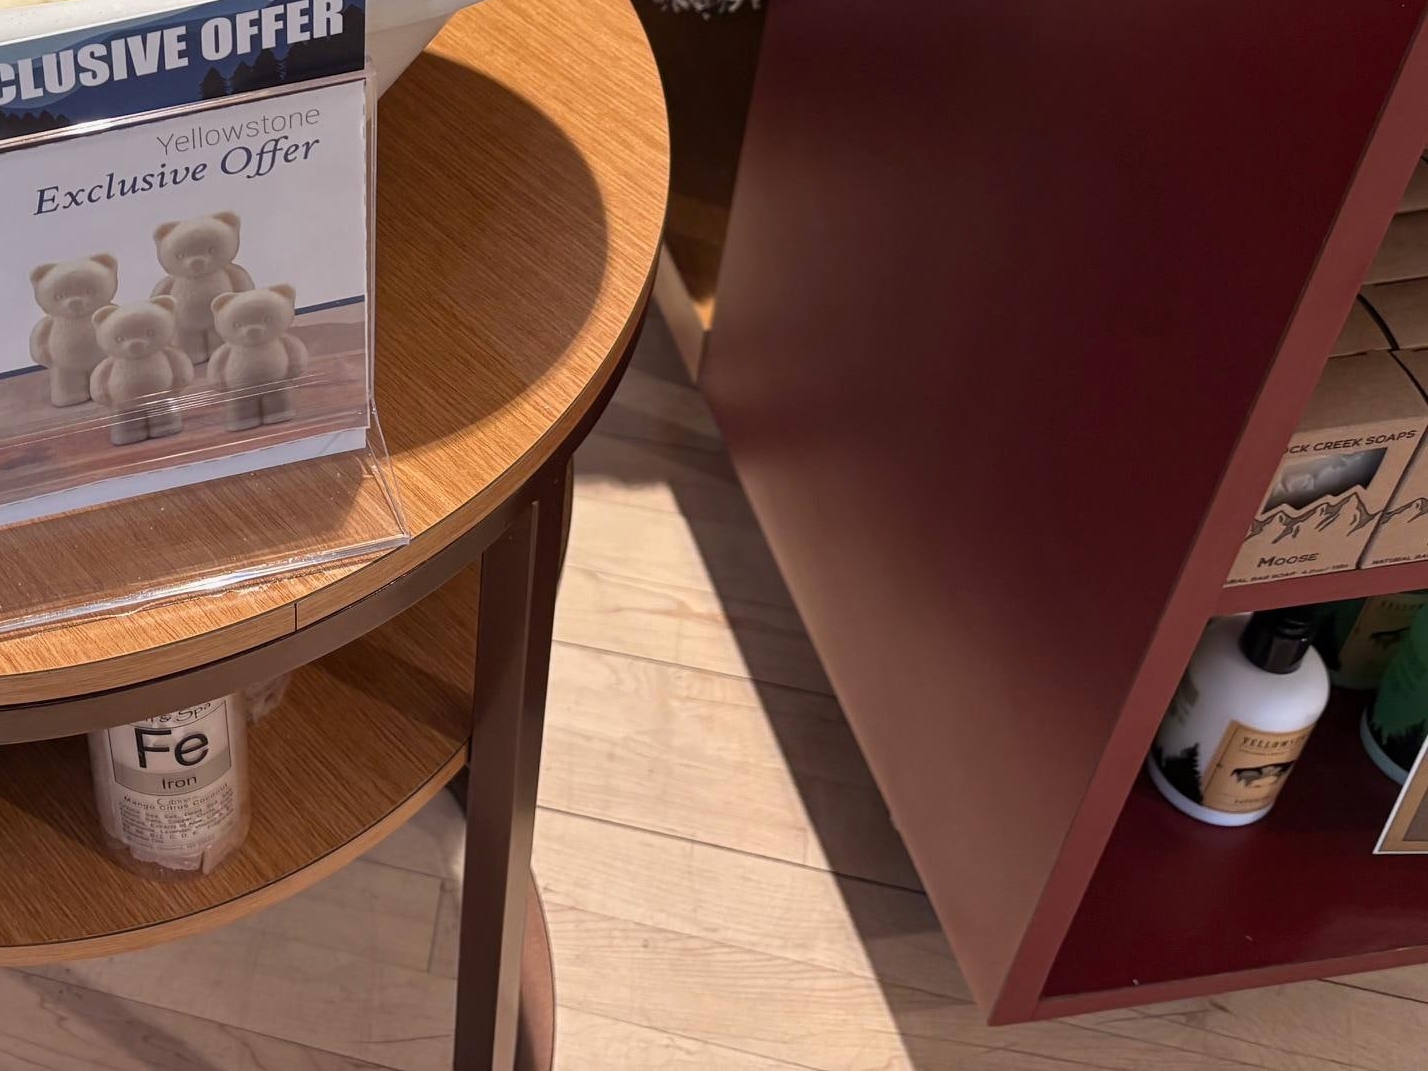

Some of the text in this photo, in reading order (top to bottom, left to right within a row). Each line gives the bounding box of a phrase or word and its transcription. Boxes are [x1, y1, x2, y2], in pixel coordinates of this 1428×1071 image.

[156, 105, 321, 156] Yellowstone
[33, 136, 321, 216] Exclusive Offer
[1313, 437, 1362, 451] CREEK
[1365, 430, 1417, 445] SOAPS
[176, 702, 211, 722] Spa
[134, 727, 209, 769] Fe
[162, 776, 197, 790] Iron
